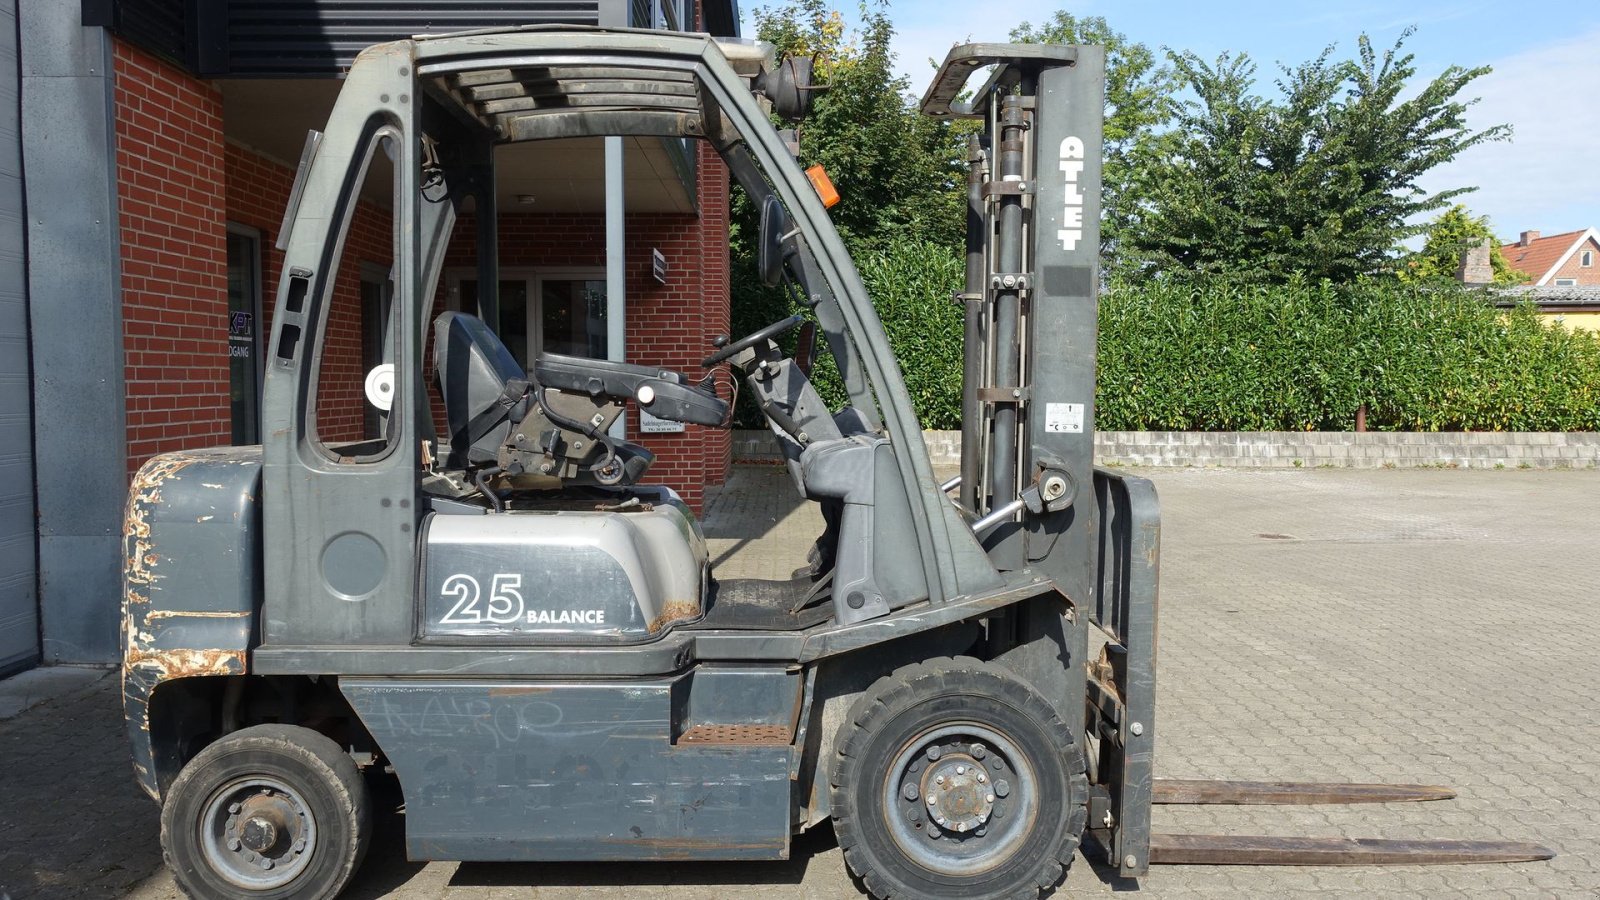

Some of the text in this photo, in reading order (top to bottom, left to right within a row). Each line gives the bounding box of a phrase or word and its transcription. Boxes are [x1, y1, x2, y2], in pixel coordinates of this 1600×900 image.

[1057, 136, 1084, 251] ATLET
[439, 574, 605, 624] 25 BALANCE
